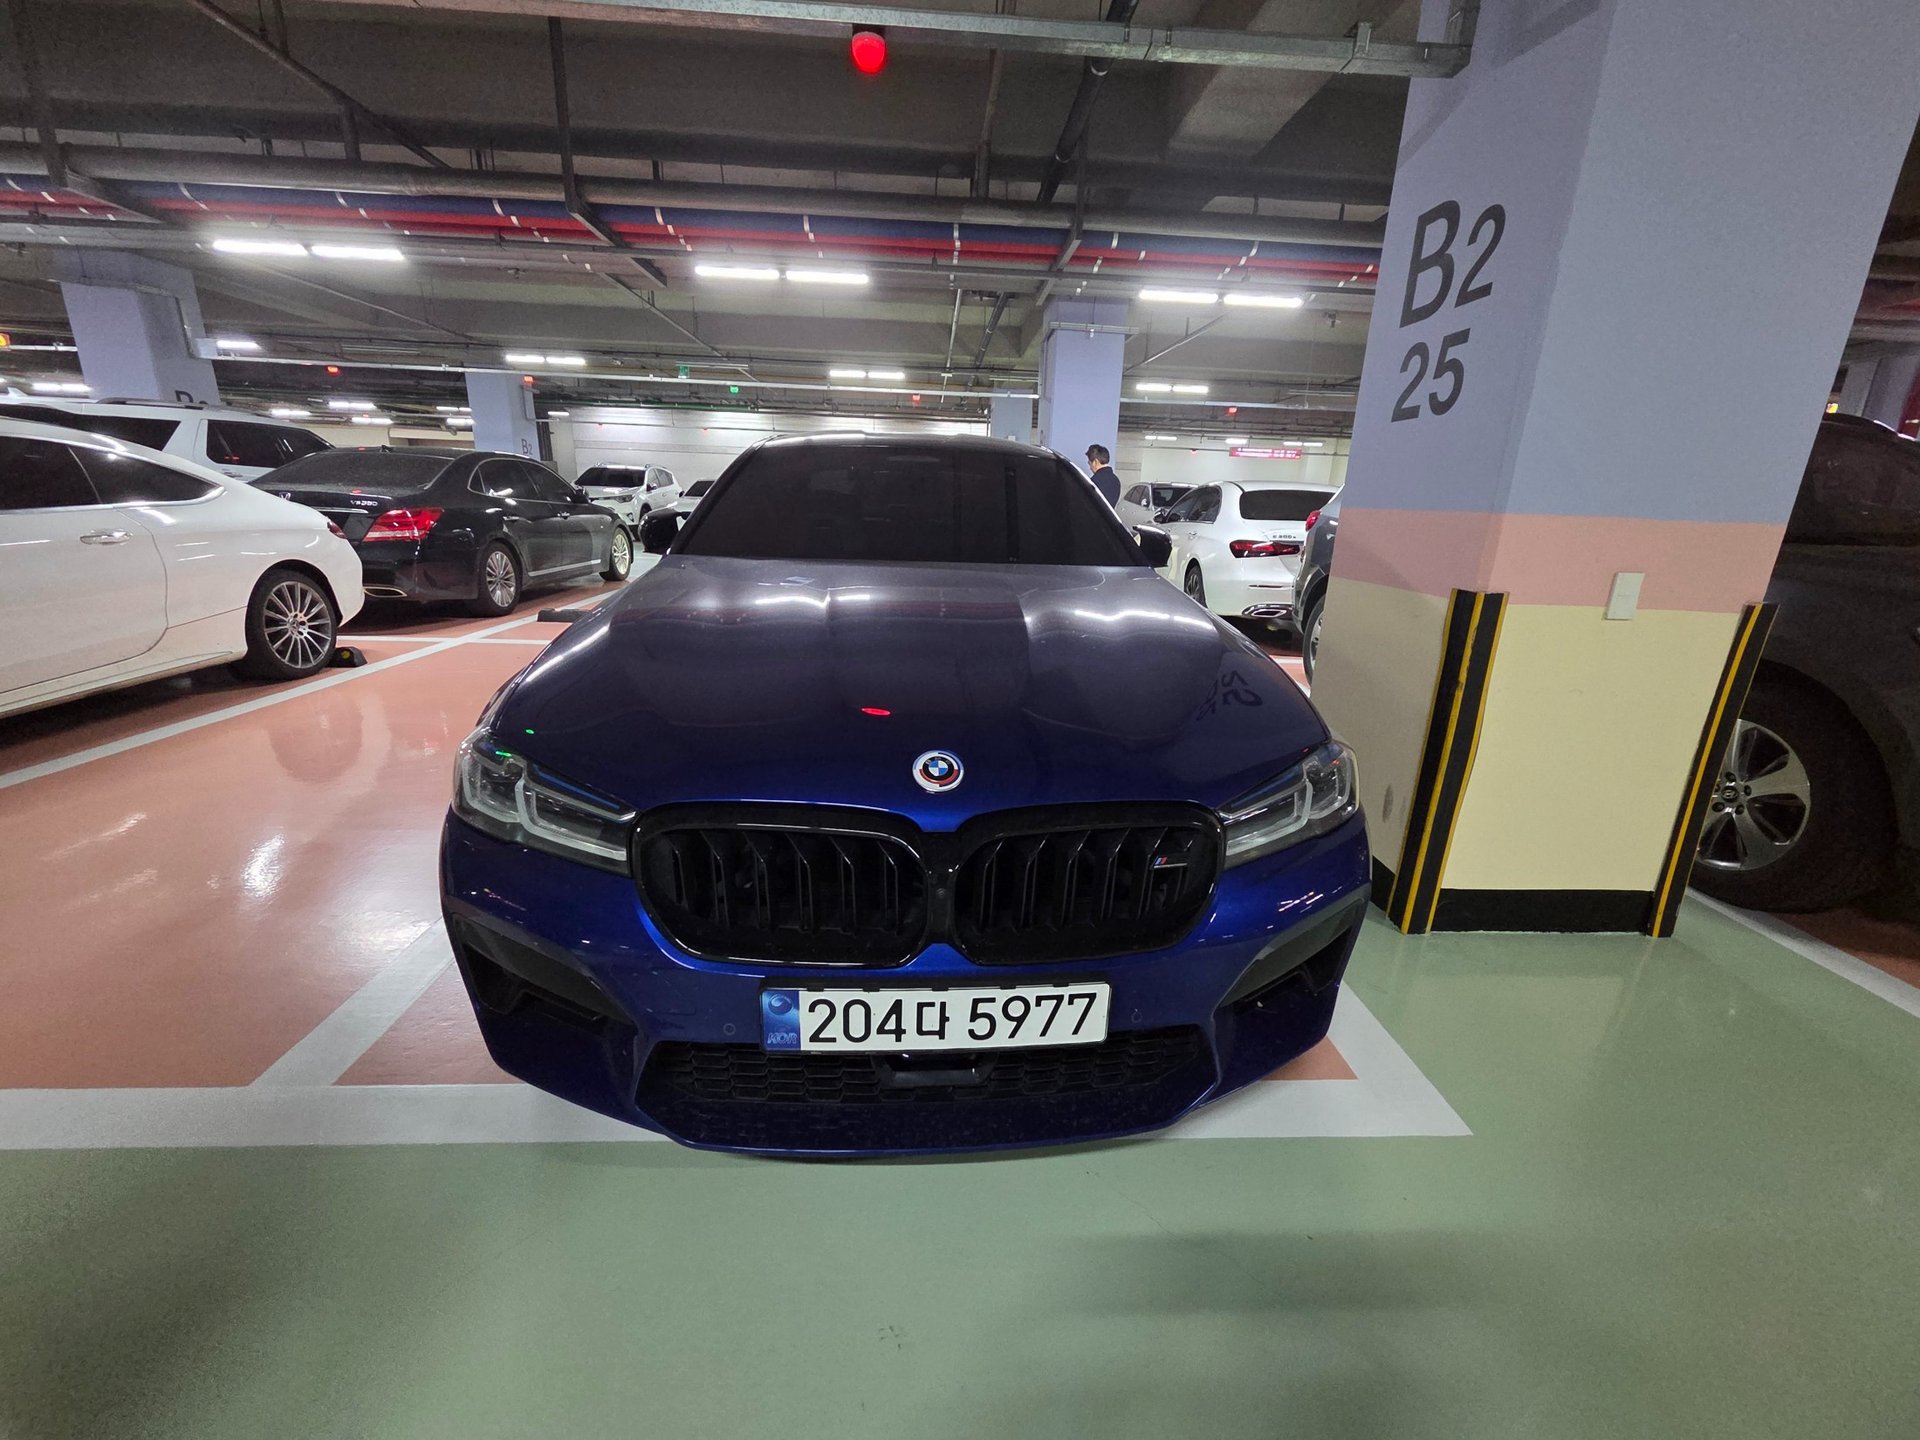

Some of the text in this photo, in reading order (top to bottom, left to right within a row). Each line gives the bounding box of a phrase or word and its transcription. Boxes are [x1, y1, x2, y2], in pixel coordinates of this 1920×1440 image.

[1399, 199, 1506, 328] B2
[1391, 328, 1471, 423] 25
[521, 438, 533, 456] B2
[808, 992, 1098, 1044] 204다 5977
